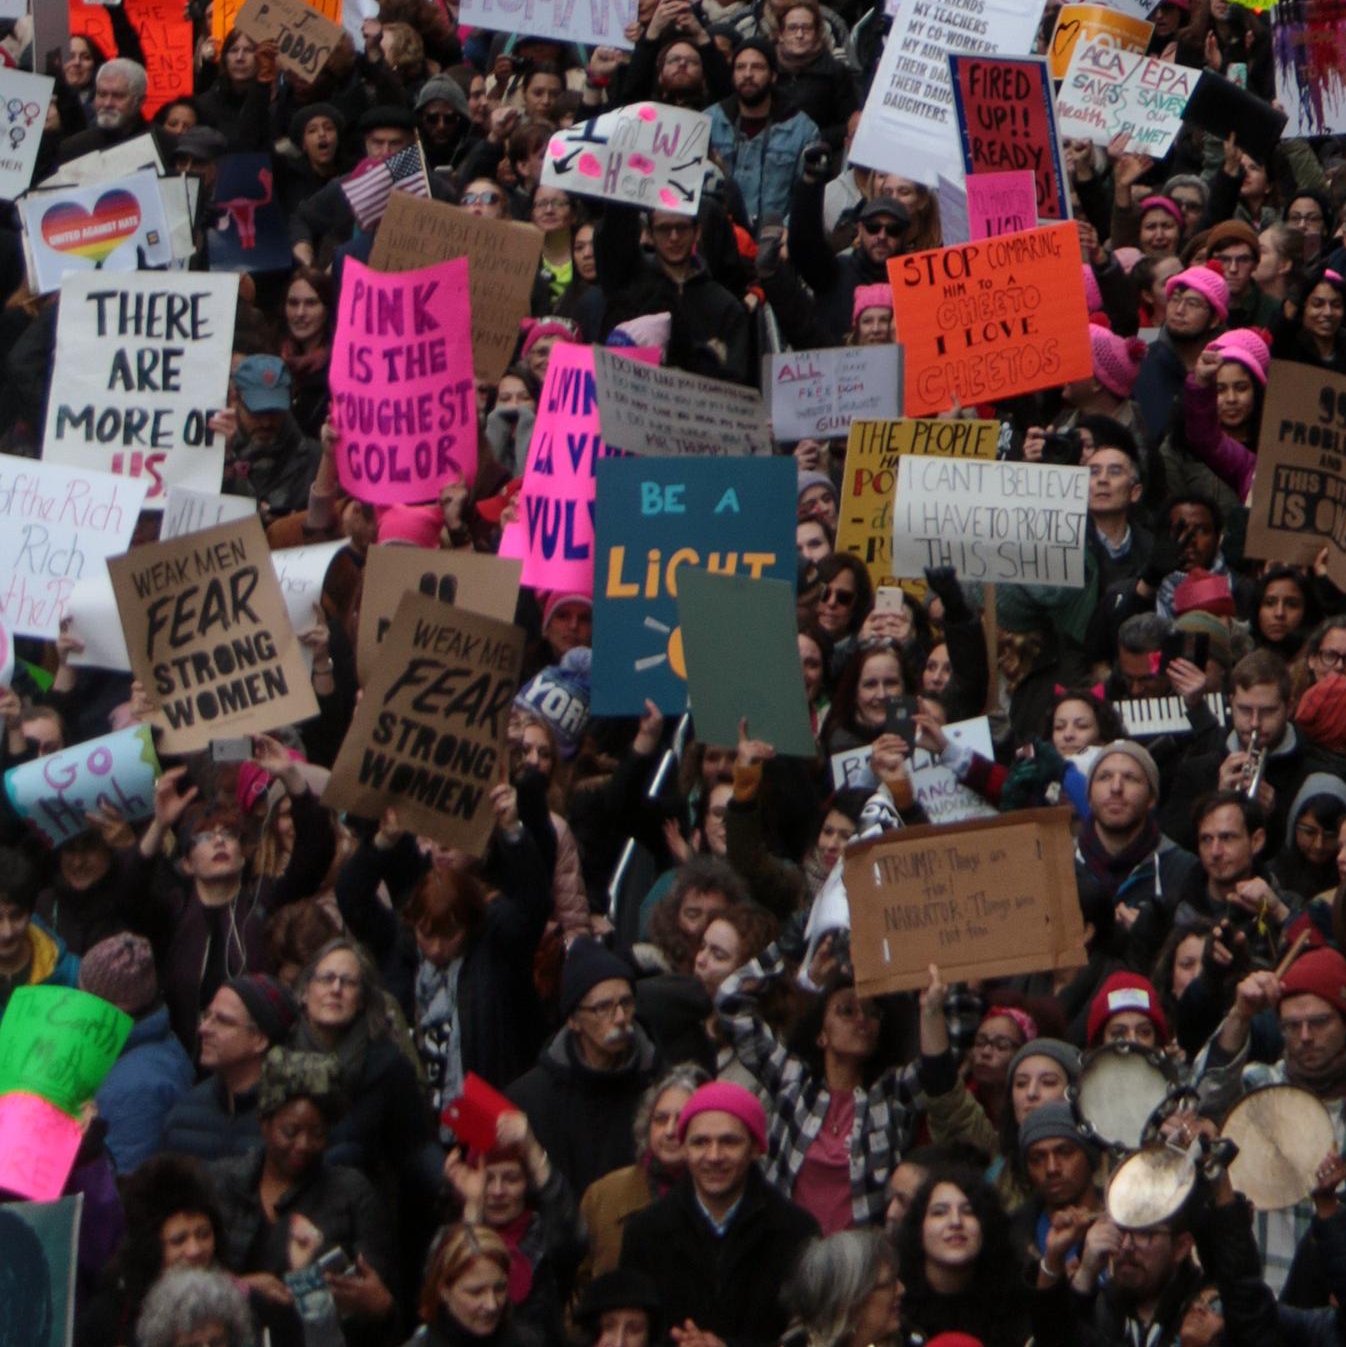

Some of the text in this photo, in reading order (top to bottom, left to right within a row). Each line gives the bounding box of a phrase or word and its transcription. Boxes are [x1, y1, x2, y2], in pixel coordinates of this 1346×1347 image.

[969, 63, 1031, 101] FIRED
[976, 105, 1031, 138] UP!!
[973, 138, 1043, 172] READY
[86, 289, 214, 342] THERE
[350, 278, 440, 338] PINK
[107, 348, 183, 393] ARE
[347, 338, 448, 383] IS THE
[55, 404, 171, 448] MORE
[331, 380, 474, 436] TOUGHEST
[345, 435, 460, 485] COLOR
[1000, 466, 1086, 500] BELIEVE
[922, 505, 981, 536] HAVE
[982, 508, 1010, 536] TO
[1010, 509, 1087, 545] PROTEST
[131, 537, 246, 600] WEAK MEN
[914, 537, 1080, 581] THIS SHIT
[145, 565, 259, 663] FEAR
[152, 631, 277, 695] STRONG
[161, 666, 290, 731] WOMEN
